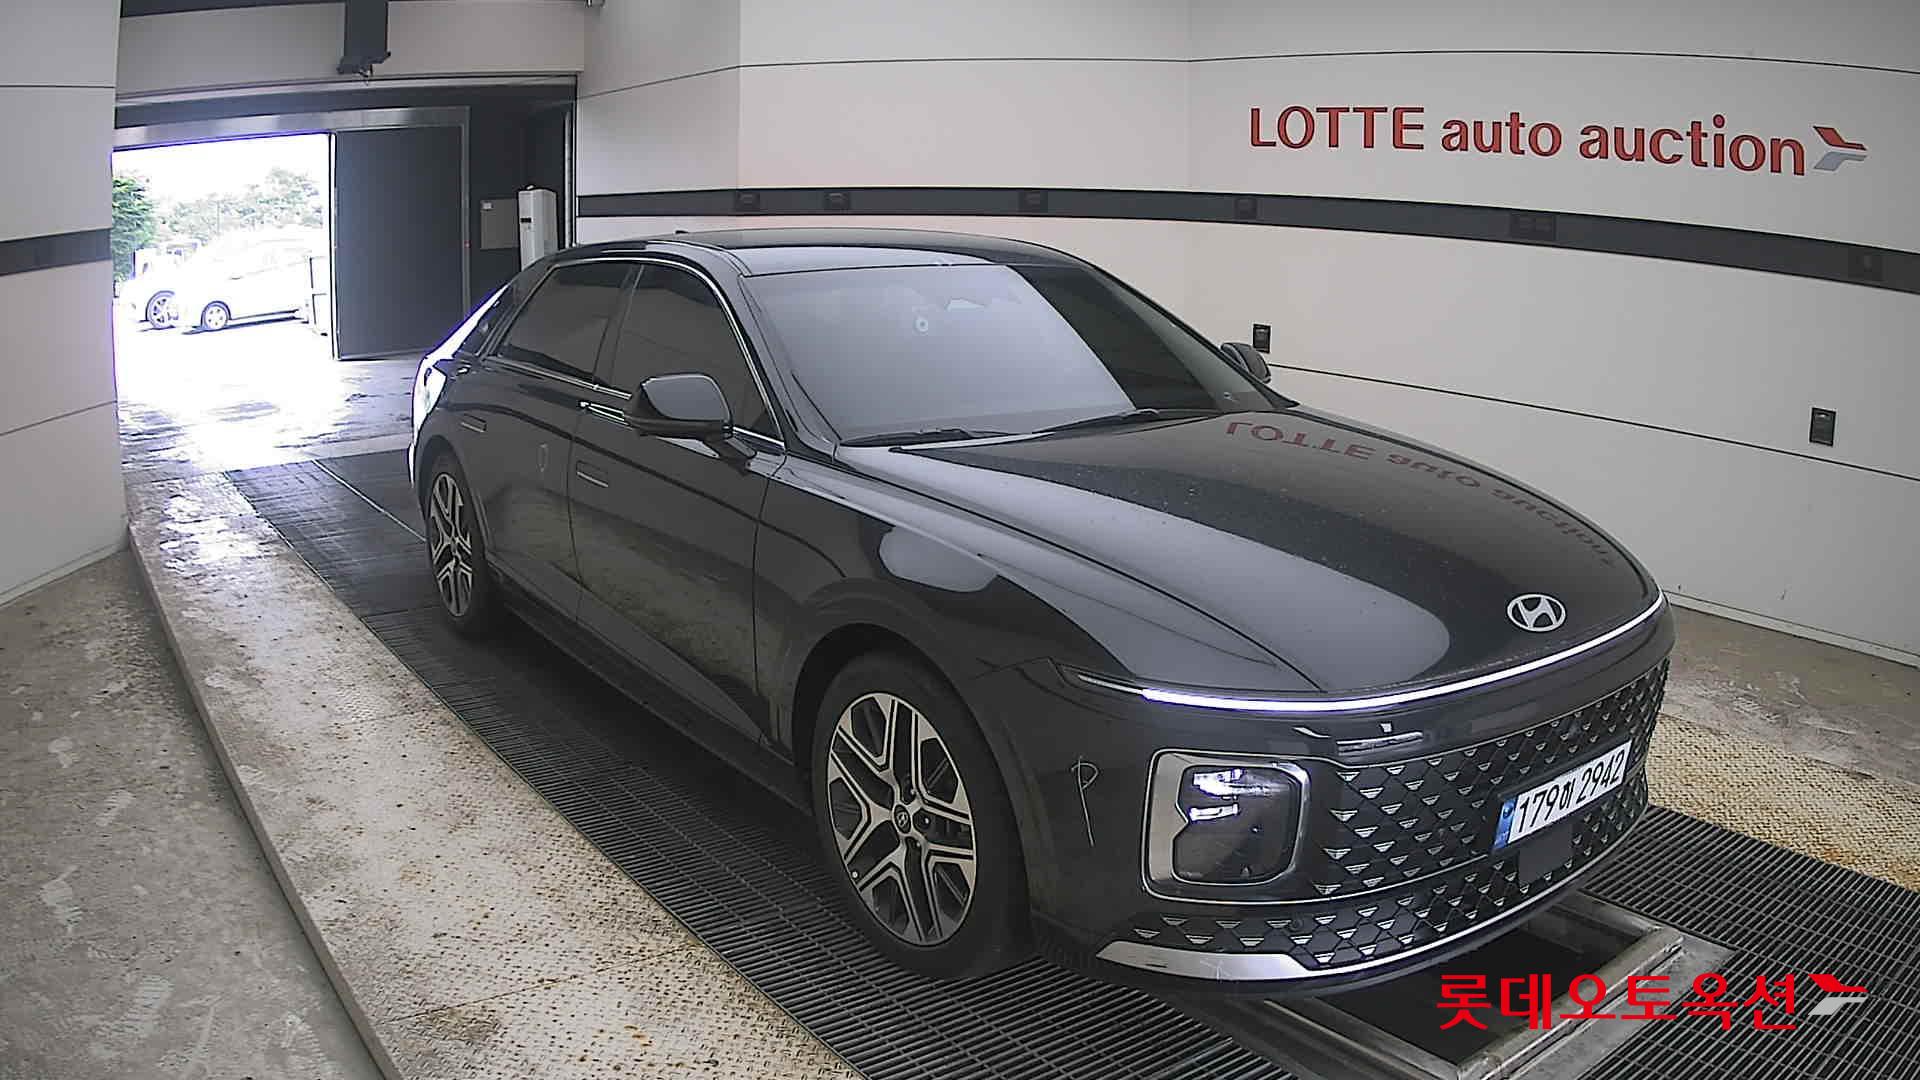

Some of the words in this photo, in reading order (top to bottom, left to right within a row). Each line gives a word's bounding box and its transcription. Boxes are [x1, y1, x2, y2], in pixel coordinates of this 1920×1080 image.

[1250, 107, 1426, 149] LOTTE
[1442, 112, 1563, 157] auto
[1579, 115, 1806, 175] auction
[1576, 749, 1625, 804] 2942
